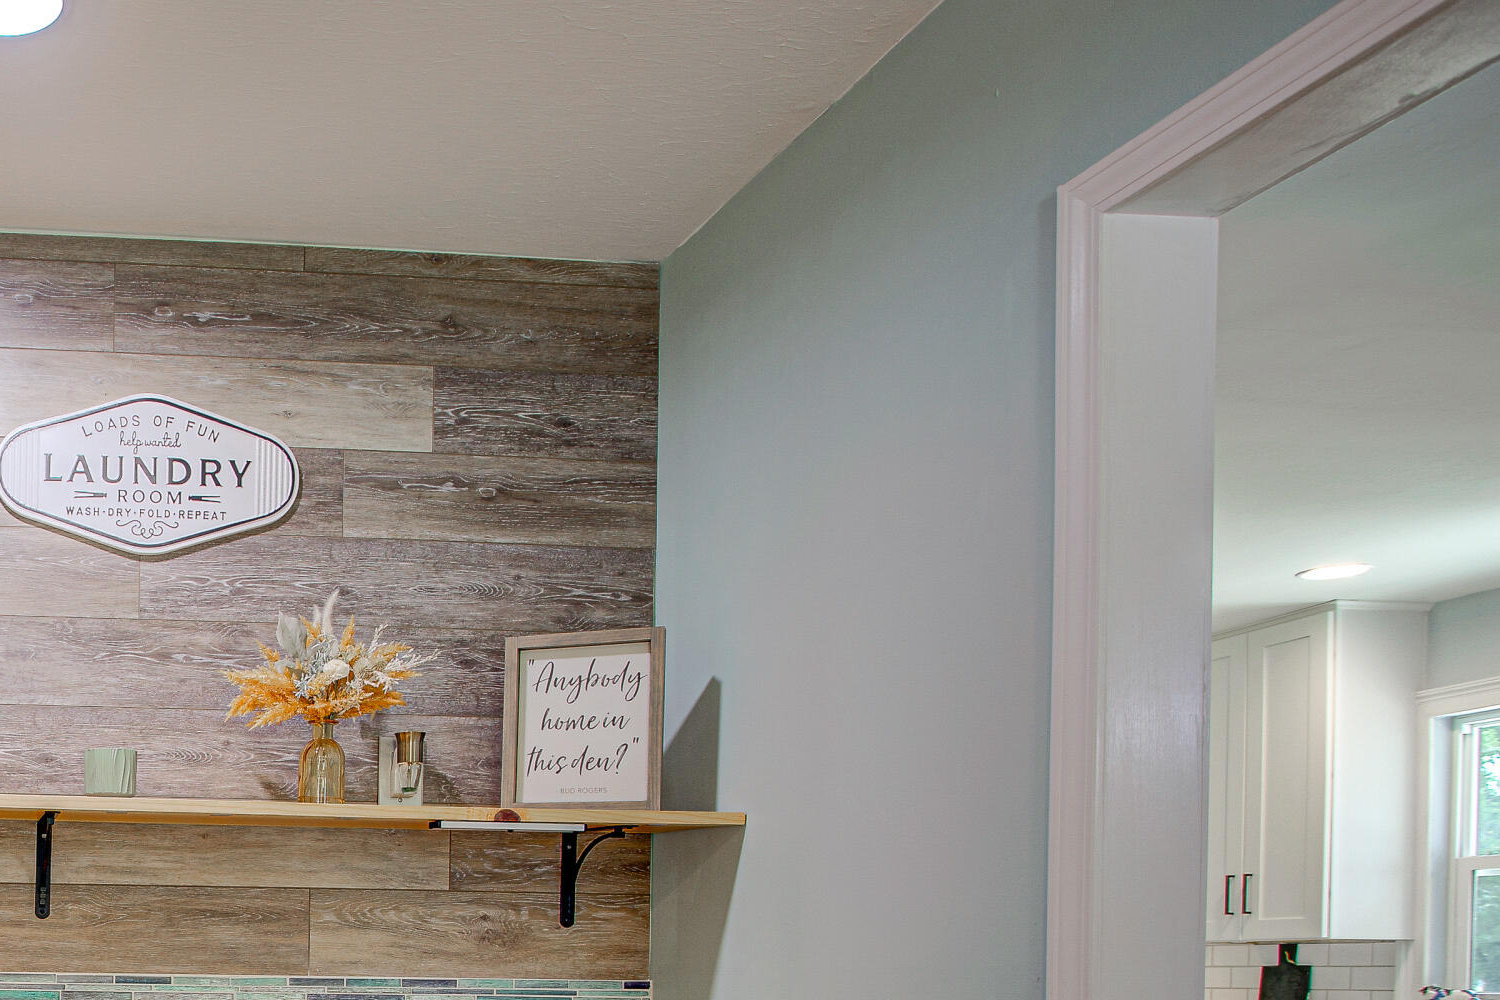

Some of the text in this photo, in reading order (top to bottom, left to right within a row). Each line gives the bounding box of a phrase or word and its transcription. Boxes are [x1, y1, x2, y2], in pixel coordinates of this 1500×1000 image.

[81, 414, 220, 443] LOADS OF FUN
[119, 430, 182, 454] help wanted
[43, 452, 253, 488] LAUNDRY
[117, 488, 183, 505] ROOM
[541, 707, 631, 731] home in
[526, 746, 568, 777] this
